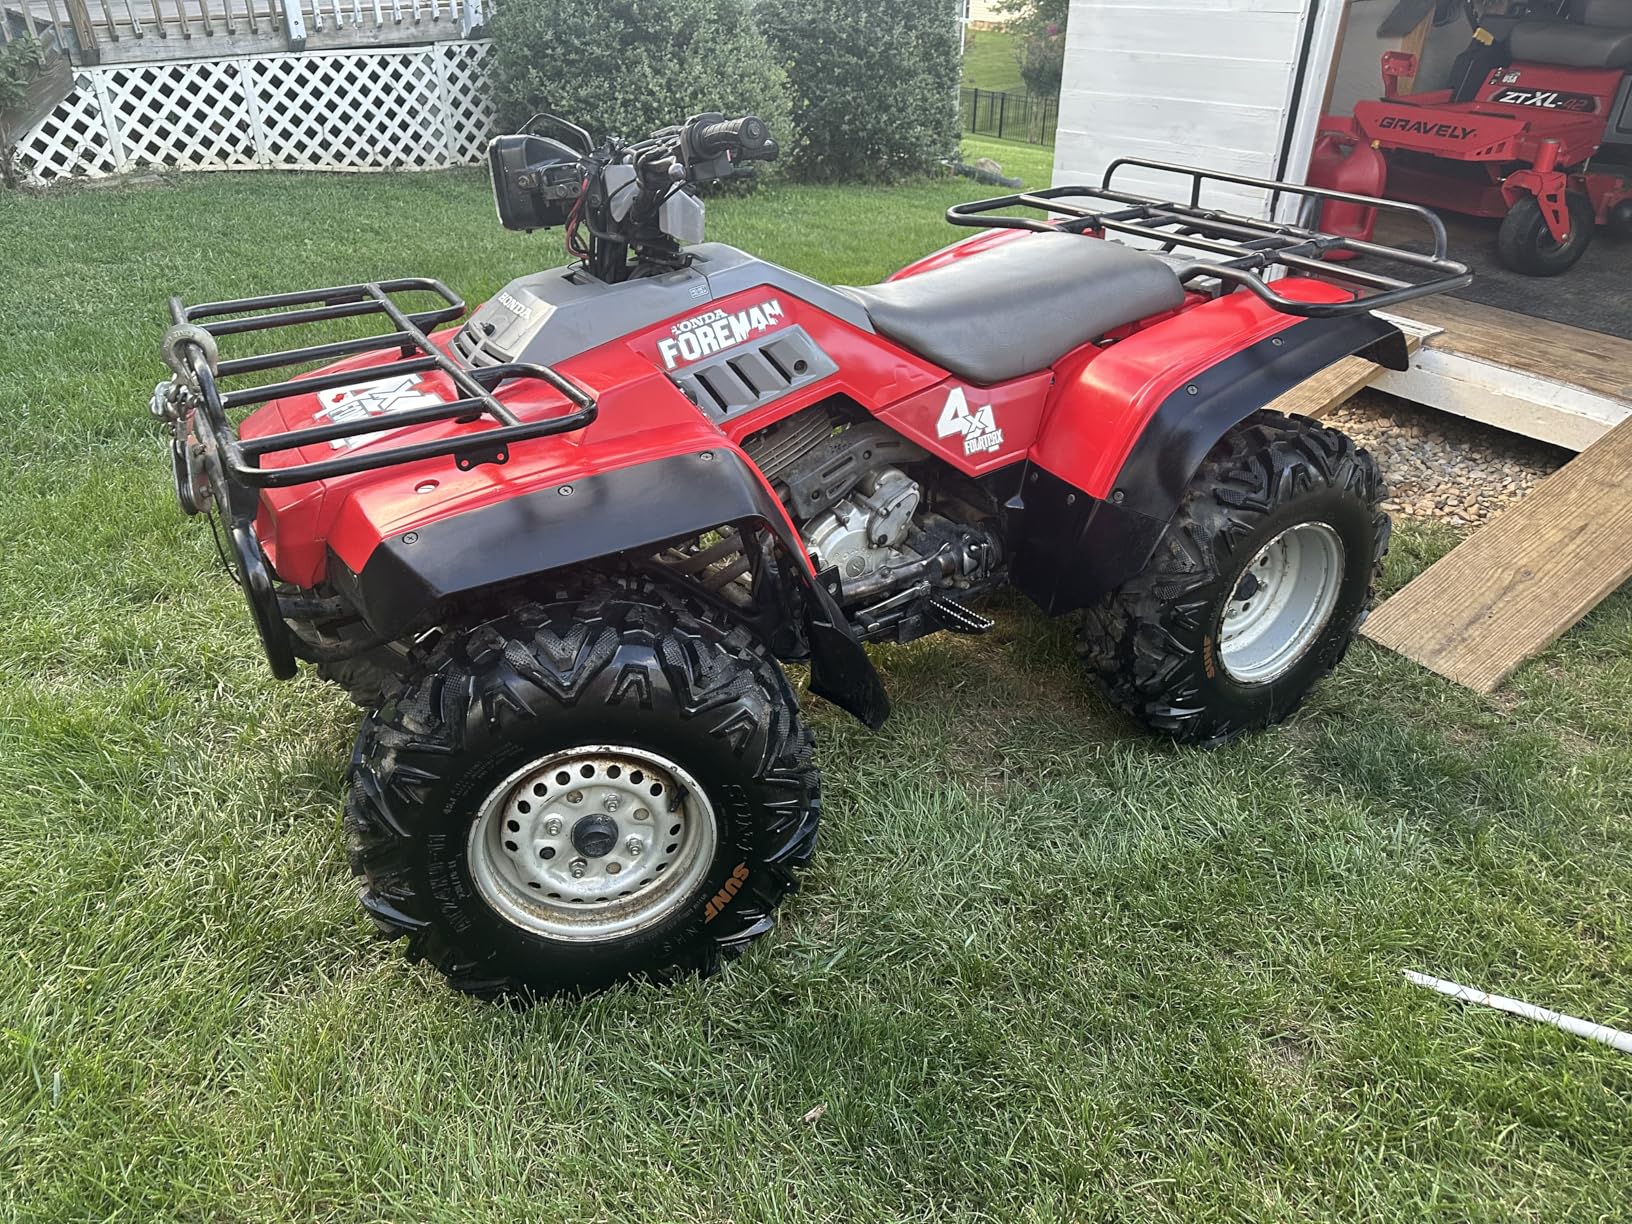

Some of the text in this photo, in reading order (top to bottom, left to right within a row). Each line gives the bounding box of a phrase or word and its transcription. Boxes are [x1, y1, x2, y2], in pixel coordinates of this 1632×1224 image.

[1379, 117, 1477, 140] GRAVELY
[498, 292, 533, 320] HONDA
[657, 300, 784, 370] FOREMAN
[704, 862, 750, 924] SUNF
